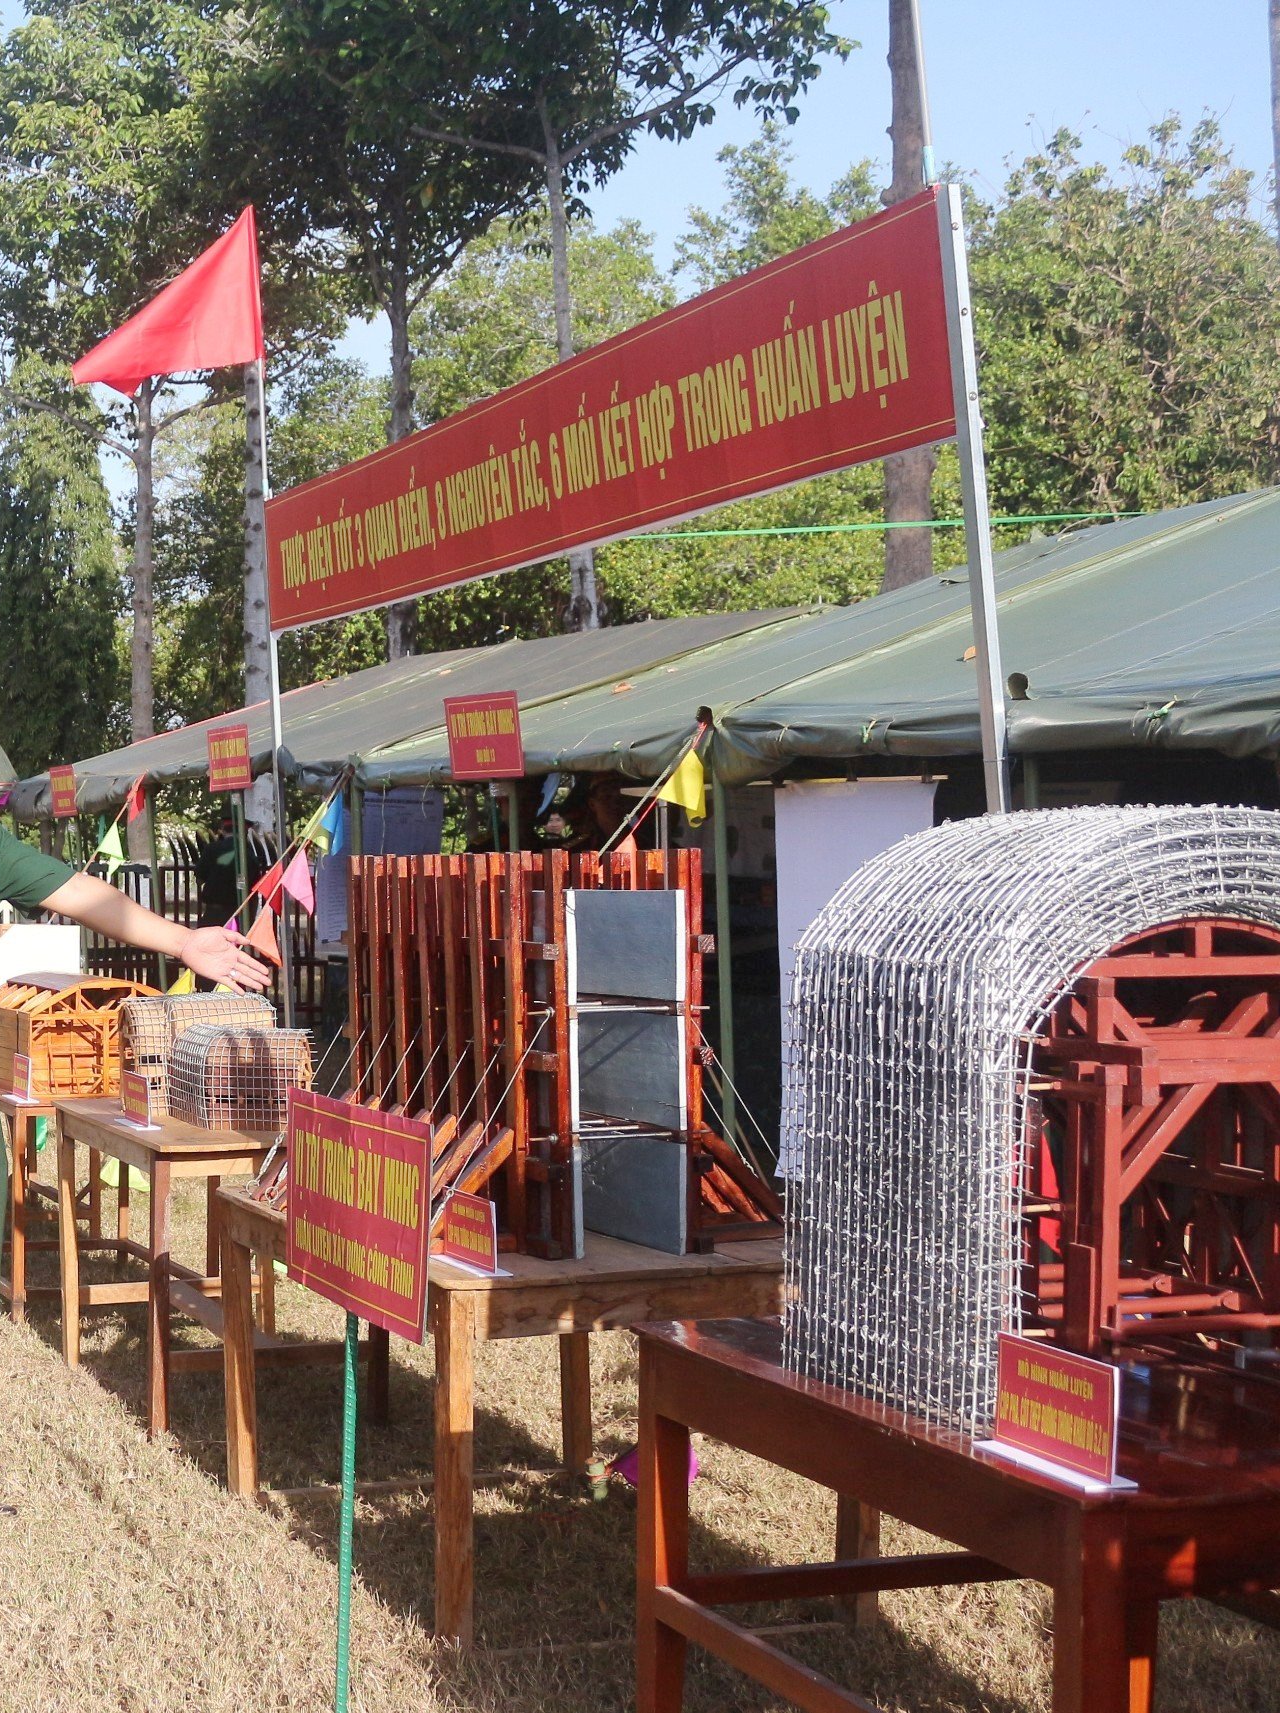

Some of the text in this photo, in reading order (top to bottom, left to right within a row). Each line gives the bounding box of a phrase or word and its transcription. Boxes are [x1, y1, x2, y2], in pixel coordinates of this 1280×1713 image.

[280, 280, 910, 598] THỰC HIỆN TỐT 3 QUAN ĐIỂM, 8 NGHUYÊN TẮC, 6 MỐI KẾT HỢP TRONG HUẤN LUYỆN
[295, 1123, 419, 1230] VỊ TRÍ TRƯNG BÀY MHHC
[296, 1210, 415, 1300] HUẤN LUYỆN XÂY DỰNG CÔNG TRÌNH
[1070, 1377, 1093, 1402] LUYỆN
